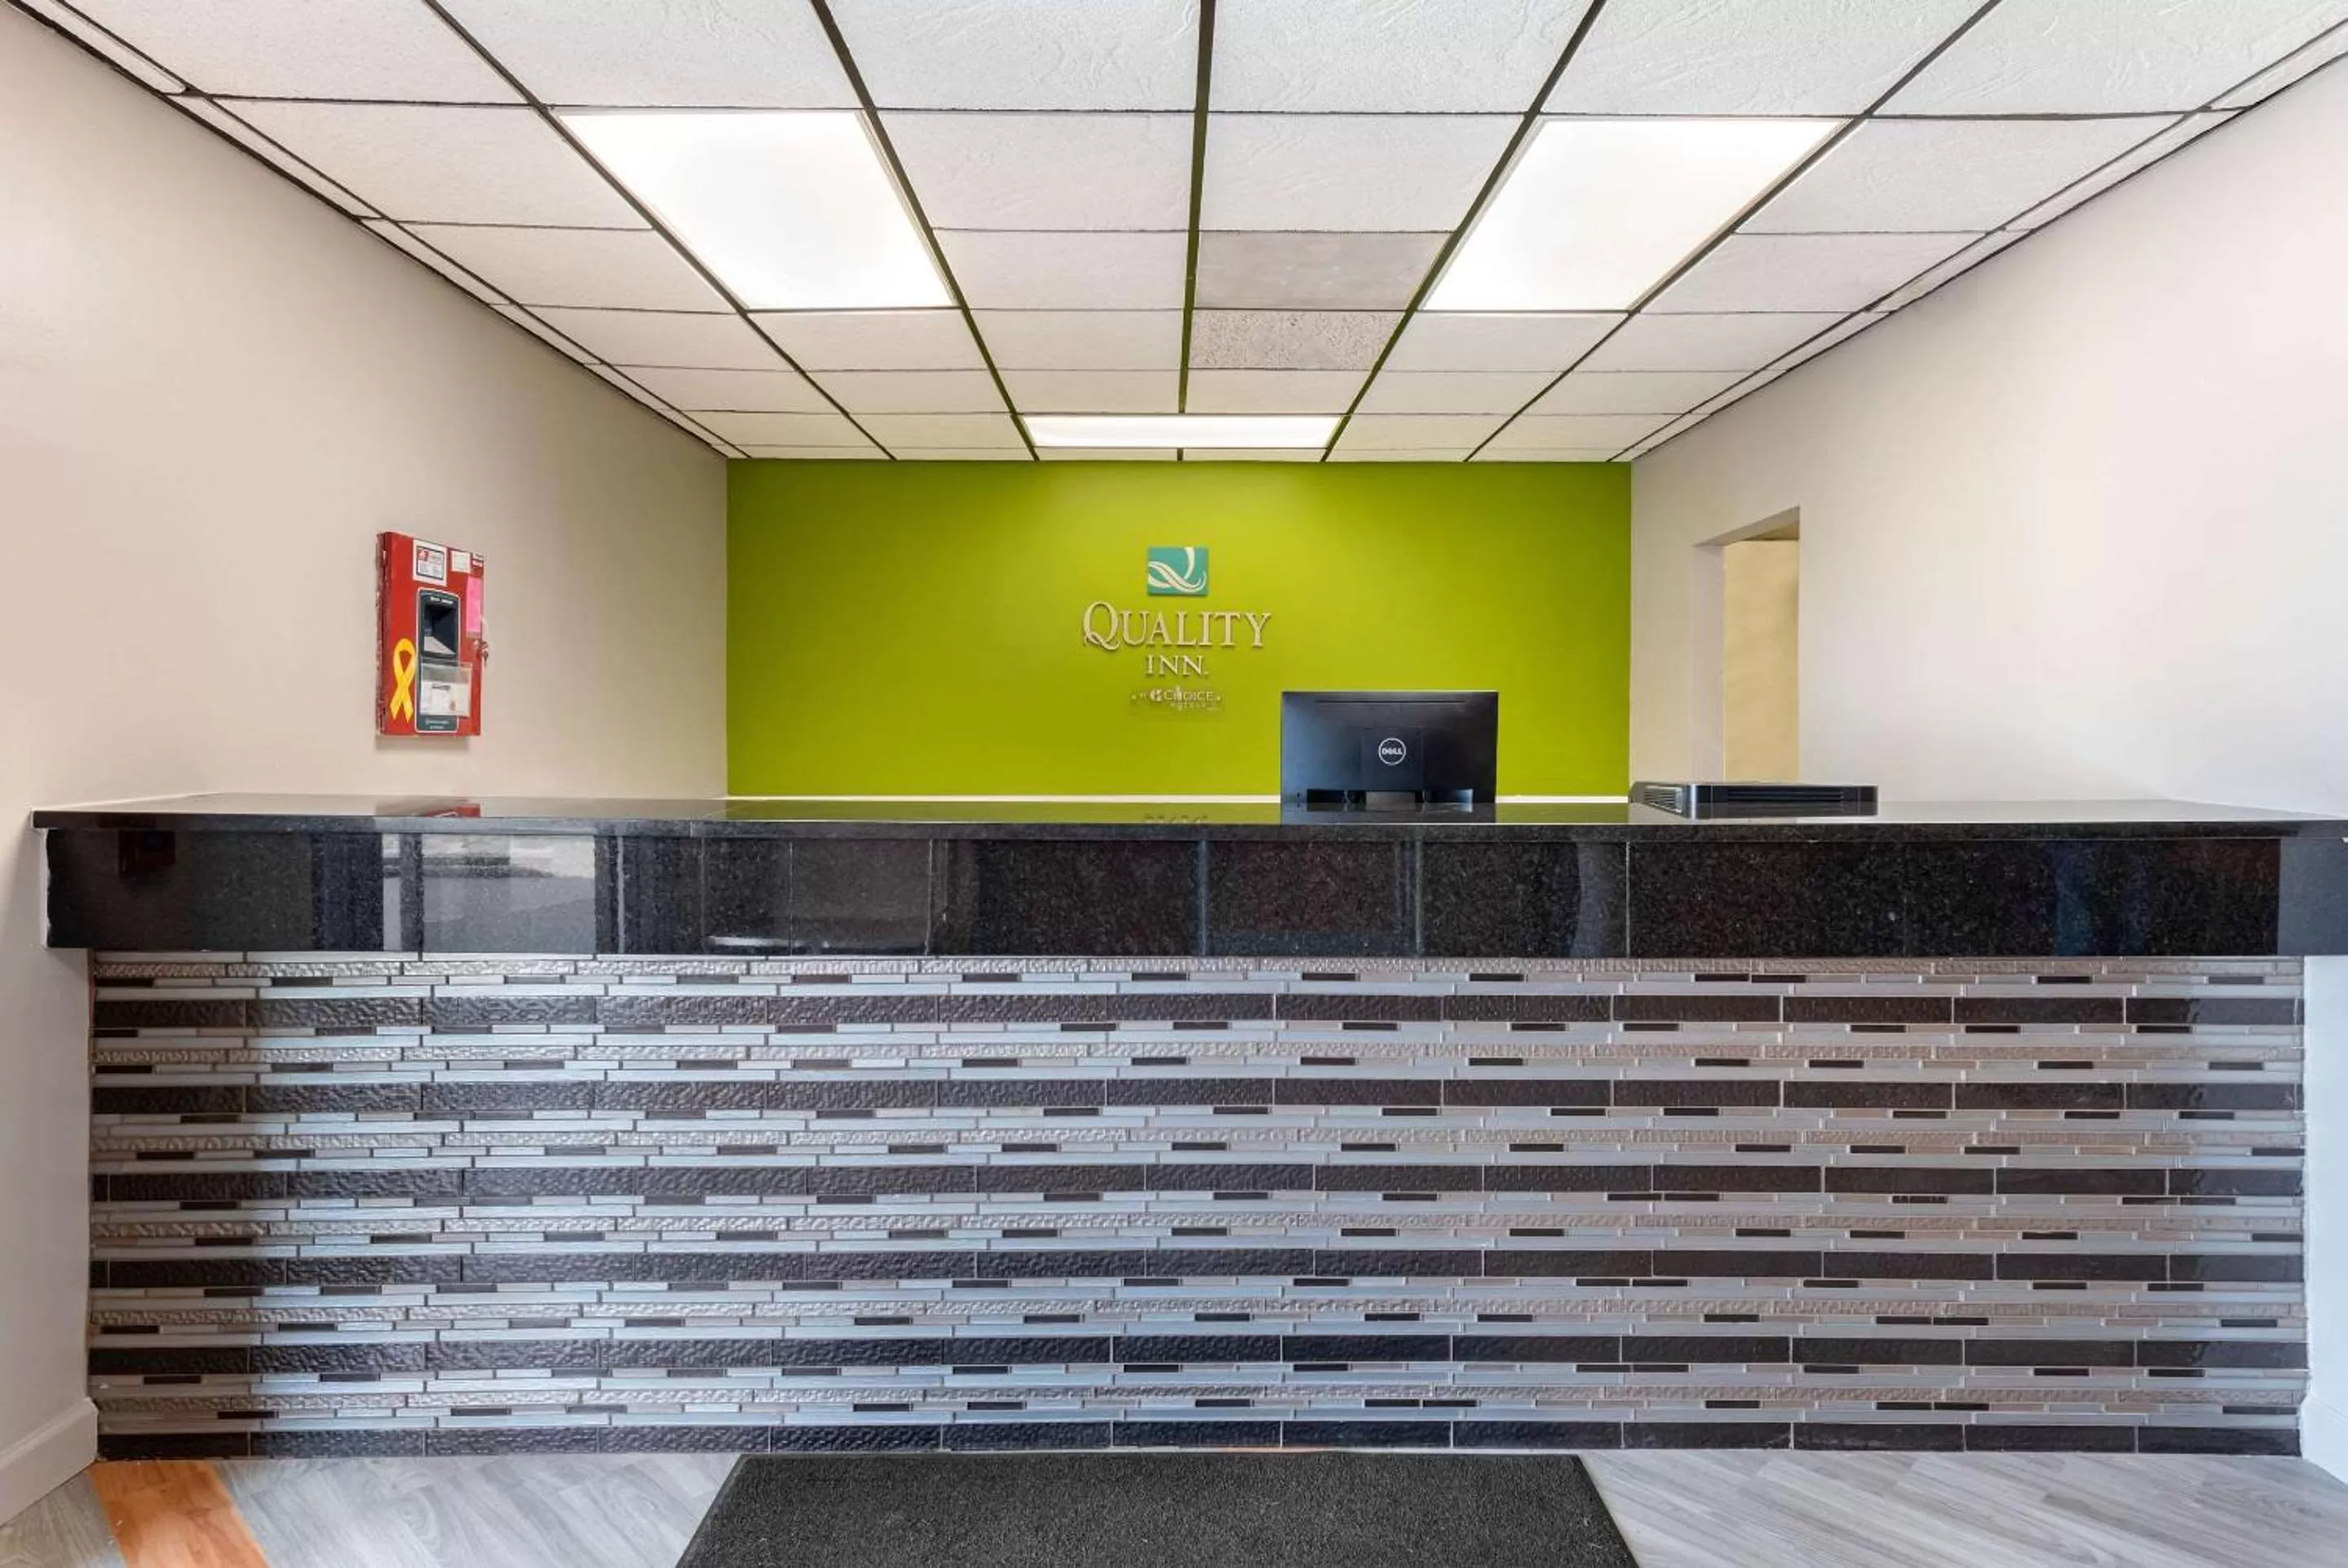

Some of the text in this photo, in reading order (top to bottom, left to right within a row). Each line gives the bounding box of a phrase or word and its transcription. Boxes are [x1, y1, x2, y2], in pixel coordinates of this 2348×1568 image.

[1083, 601, 1271, 651] QUALITY
[1146, 655, 1205, 677] INN
[1382, 747, 1404, 755] DELL
